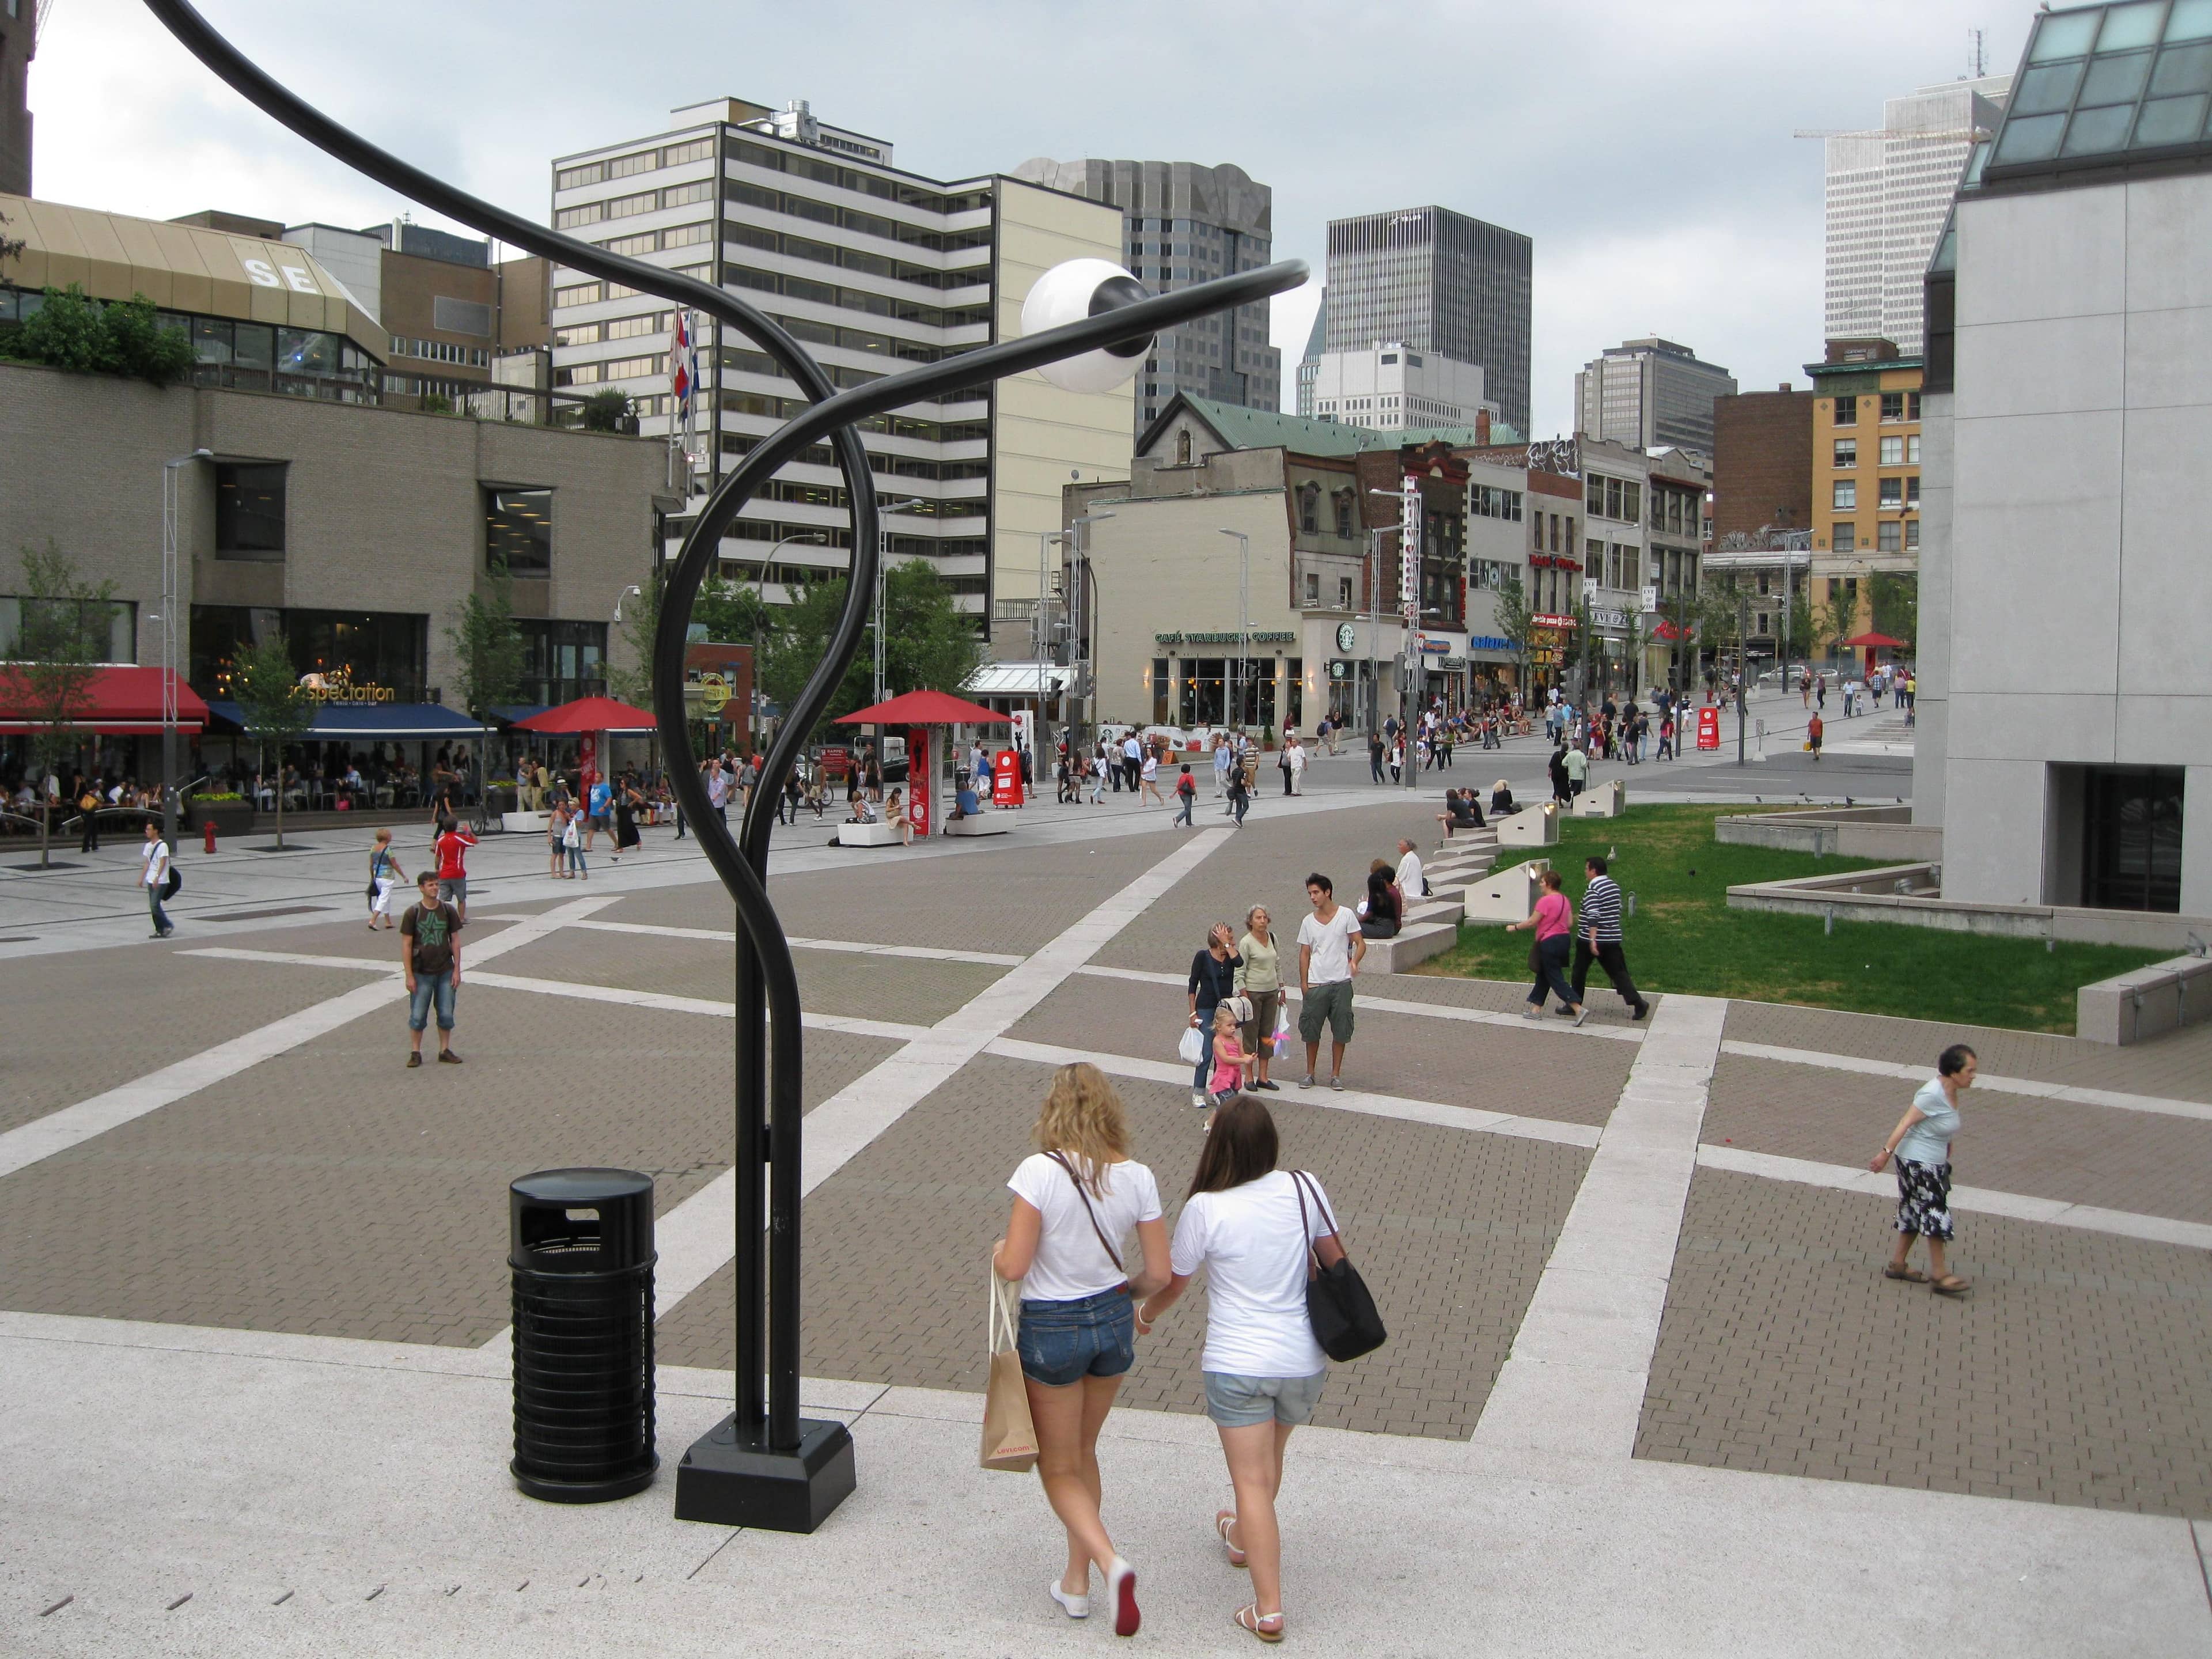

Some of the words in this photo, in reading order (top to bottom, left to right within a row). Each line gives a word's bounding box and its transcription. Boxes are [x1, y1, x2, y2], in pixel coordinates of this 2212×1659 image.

[1402, 214, 1422, 222] TELUS
[245, 259, 318, 294] SE
[1594, 612, 1611, 623] EVE
[1155, 630, 1181, 642] CAFÉ
[1252, 631, 1294, 642] COFFEE
